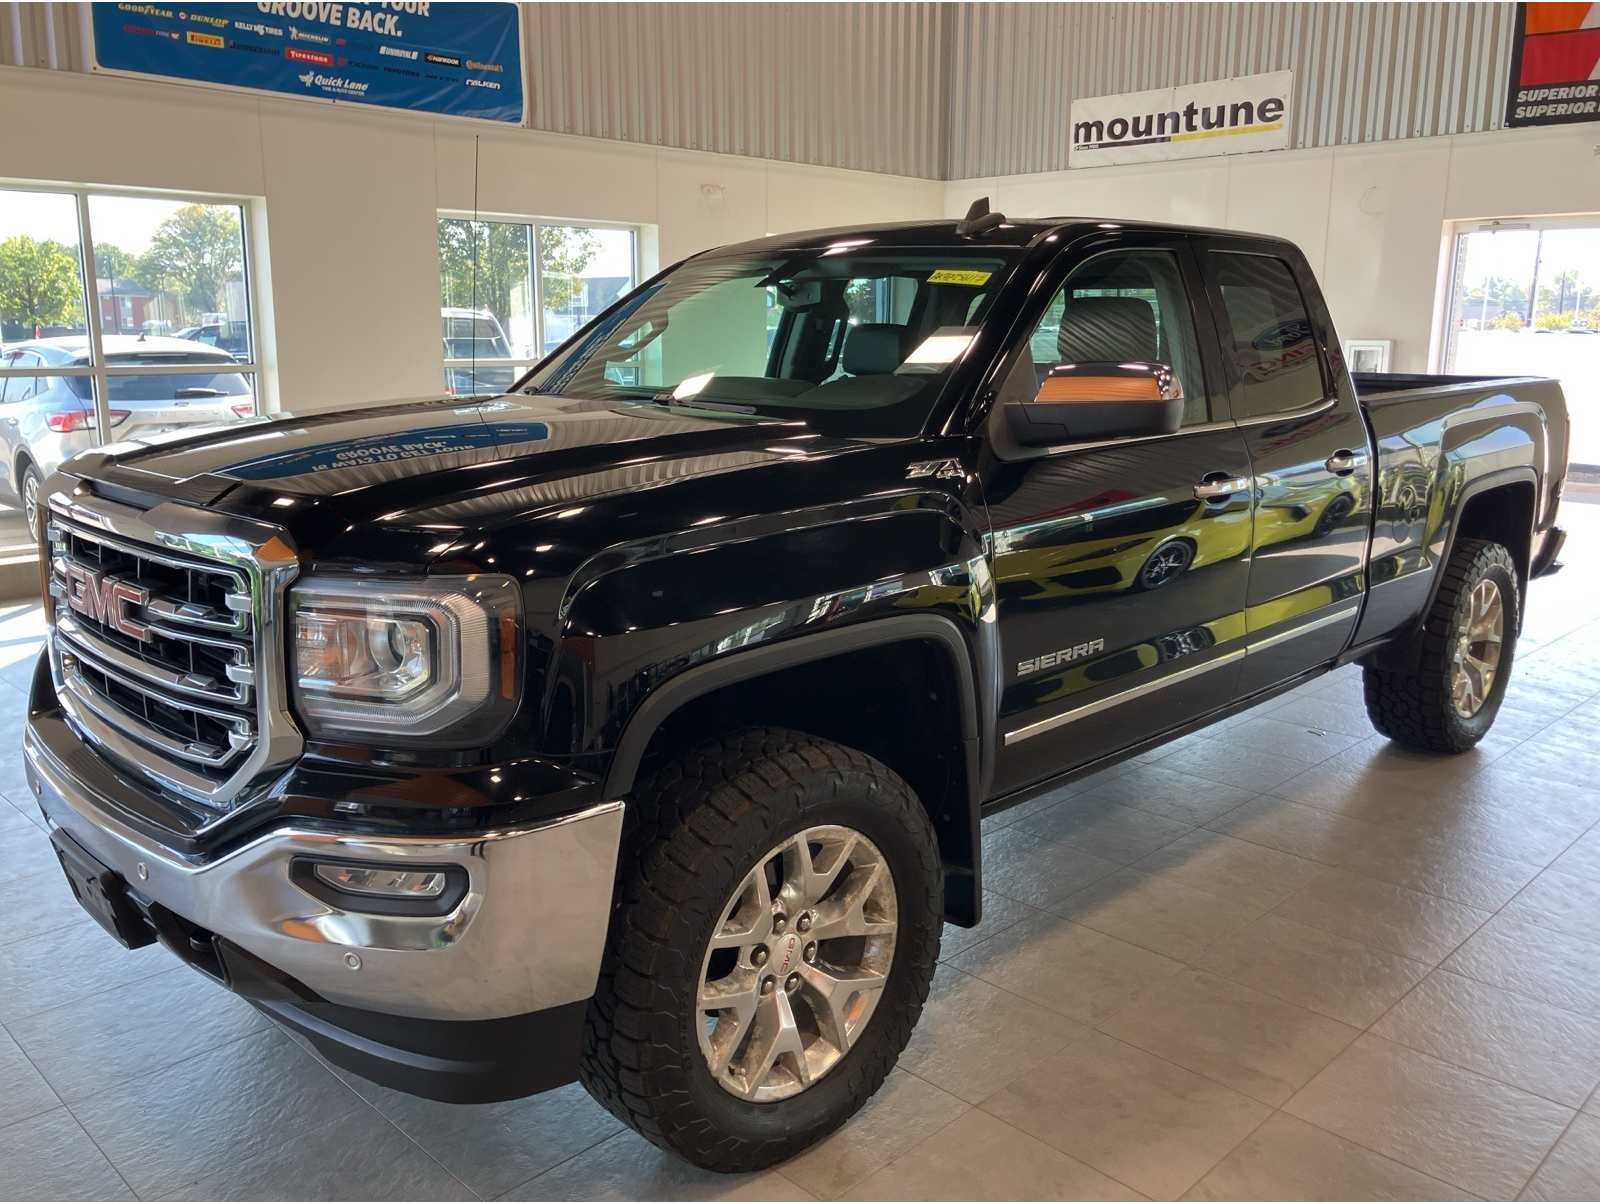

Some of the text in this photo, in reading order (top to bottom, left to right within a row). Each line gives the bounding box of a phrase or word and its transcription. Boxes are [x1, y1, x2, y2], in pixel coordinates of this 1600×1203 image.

[257, 2, 402, 37] GROOVE BACK.
[314, 74, 343, 88] Quick
[1516, 85, 1599, 103] SUPERIOR
[1074, 97, 1285, 143] mountune
[1514, 101, 1597, 119] SUPERIOR
[65, 561, 153, 644] GMC
[1016, 638, 1104, 677] SIERRA
